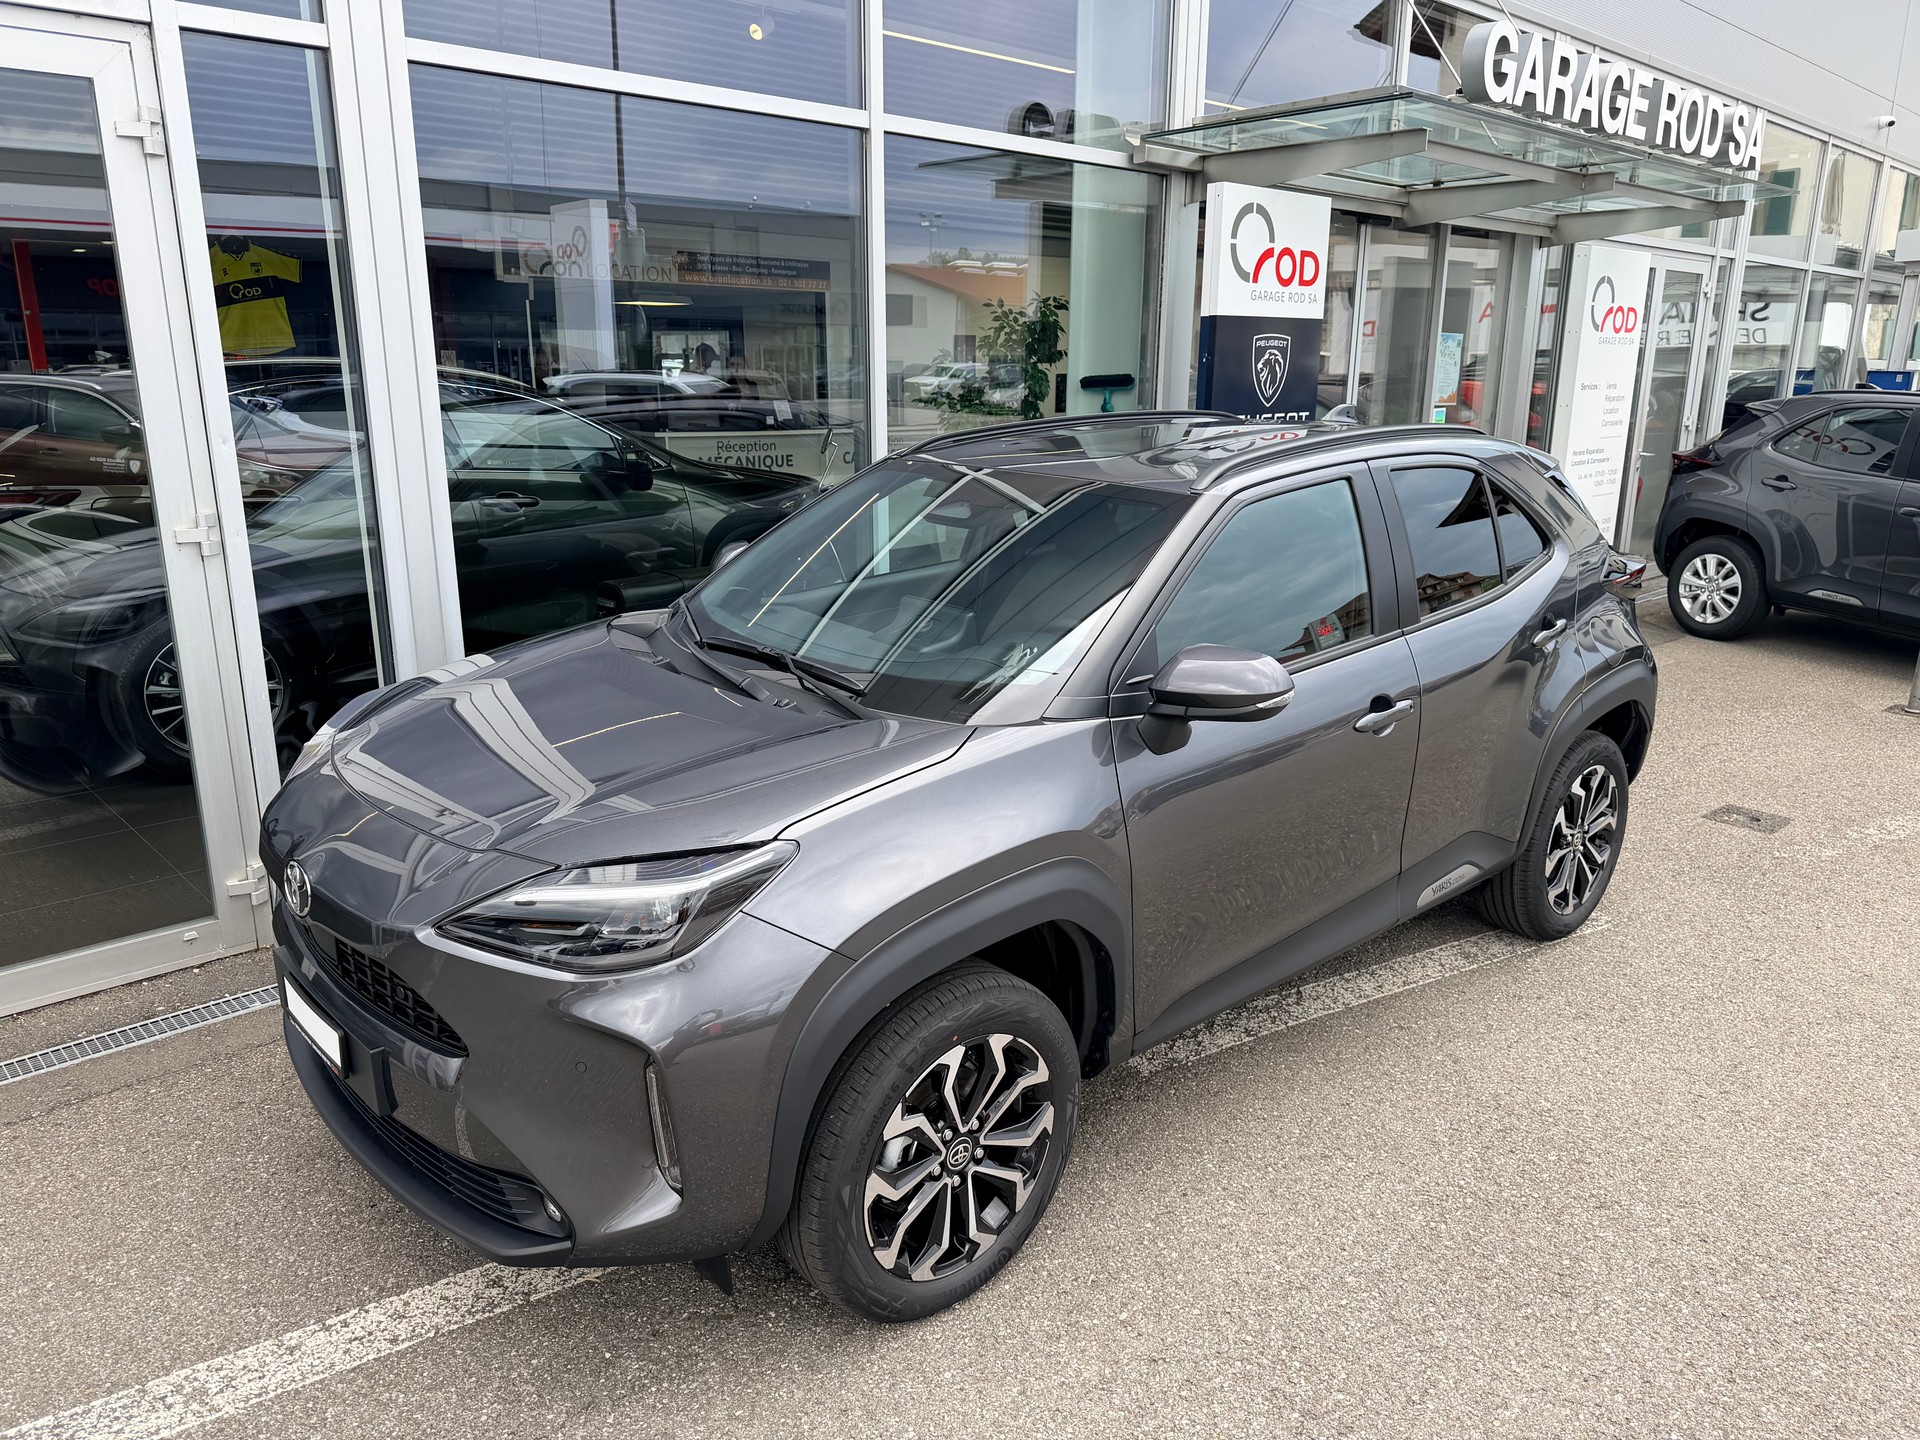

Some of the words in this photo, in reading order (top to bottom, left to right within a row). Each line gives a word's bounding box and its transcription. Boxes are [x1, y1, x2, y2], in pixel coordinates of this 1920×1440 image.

[1484, 19, 1653, 141] GARAGE
[1655, 79, 1725, 159] ROD
[1728, 105, 1763, 172] SA
[587, 262, 672, 282] LOCATION
[685, 270, 772, 285] www.oronlocation.ch
[1250, 289, 1286, 303] GARAGE
[1288, 291, 1306, 304] ROD
[1308, 293, 1318, 305] SA
[1256, 339, 1288, 348] PEUGEOT
[1598, 337, 1617, 345] GARAGE
[1617, 337, 1628, 345] ROD
[717, 440, 777, 454] Réception
[1431, 876, 1452, 897] YARIS
[849, 1093, 893, 1172] EcoContact
[889, 1081, 900, 1093] 6
